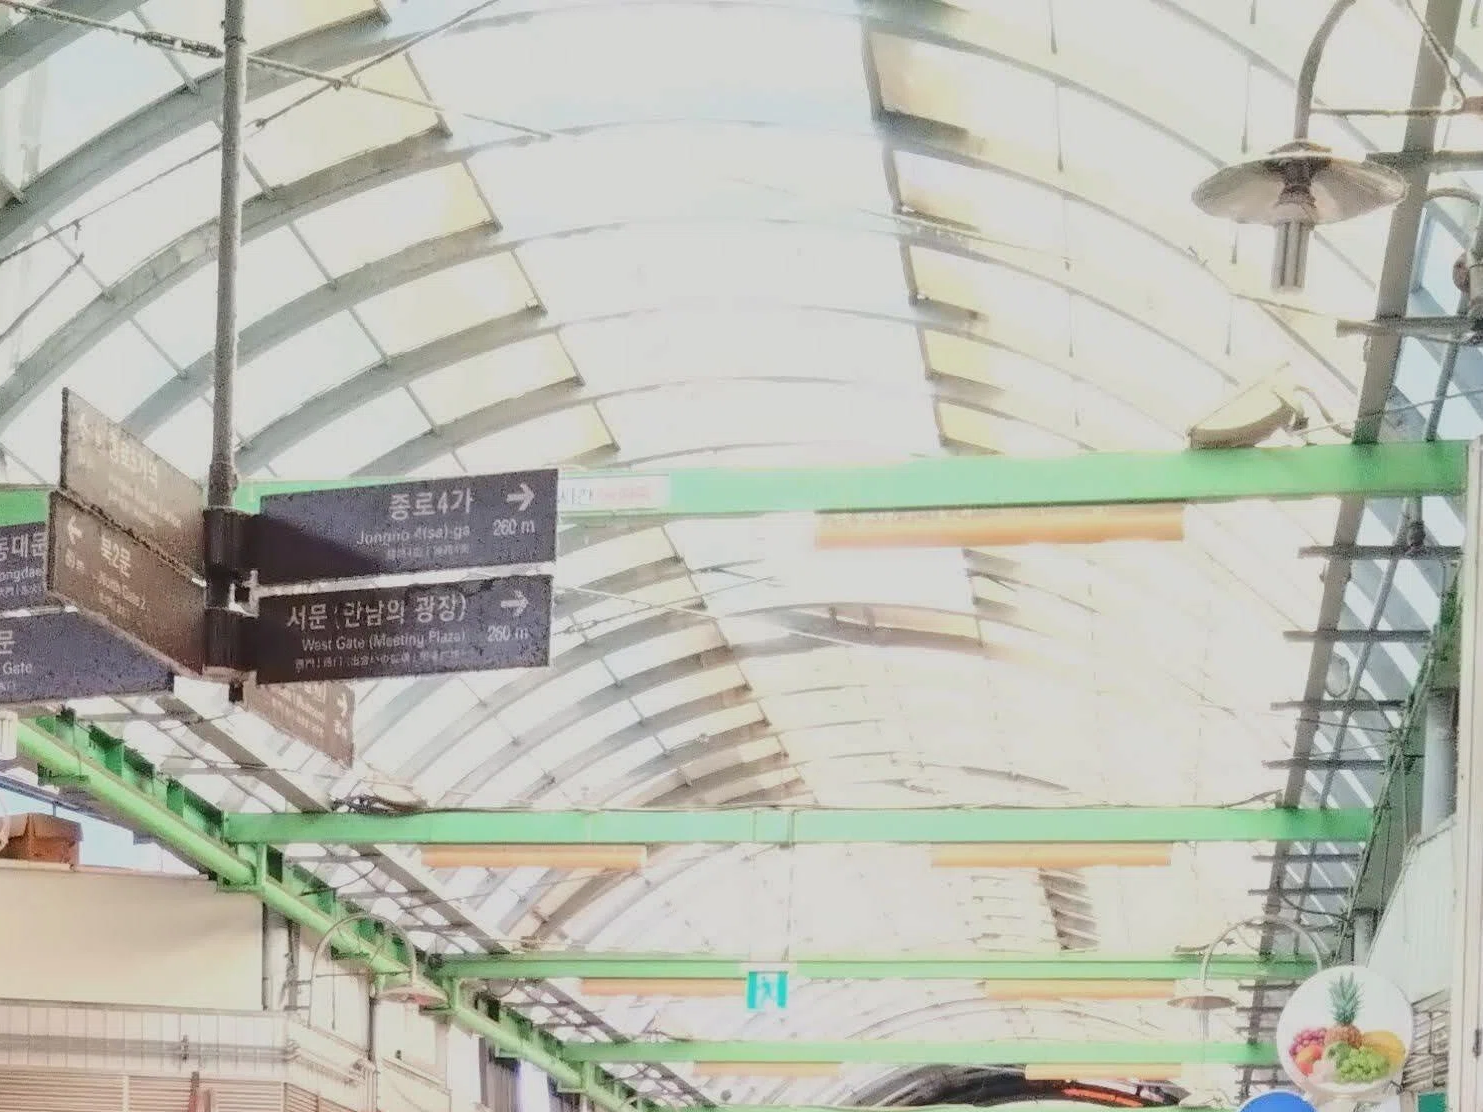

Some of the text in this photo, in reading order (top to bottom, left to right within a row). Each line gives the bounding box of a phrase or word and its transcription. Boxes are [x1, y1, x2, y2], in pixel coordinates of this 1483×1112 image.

[388, 488, 473, 521] 종로4가
[493, 519, 536, 536] 260 m
[286, 603, 327, 631] 서문
[415, 593, 467, 623] 광장)
[487, 625, 510, 642] 260
[301, 636, 332, 652] West
[336, 635, 366, 650] Gate
[2, 661, 33, 675] Gate
